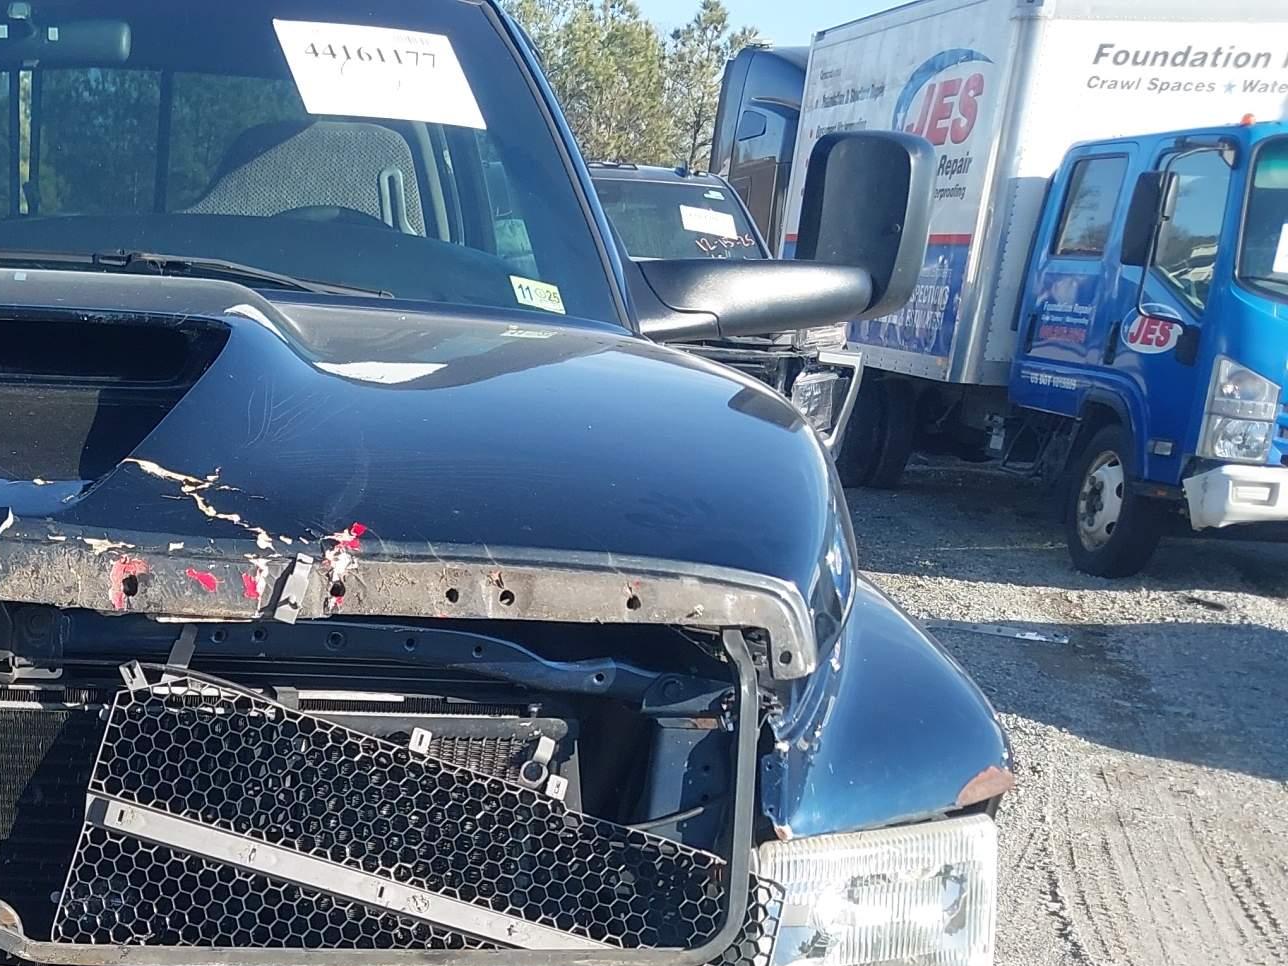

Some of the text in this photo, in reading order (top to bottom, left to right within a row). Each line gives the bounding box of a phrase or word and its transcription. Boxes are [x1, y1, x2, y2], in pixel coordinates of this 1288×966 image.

[305, 43, 436, 68] 44161177
[1092, 43, 1272, 69] Foundation
[1086, 75, 1142, 90] Crawl
[1146, 77, 1216, 94] Spaces
[904, 73, 984, 146] JES
[936, 152, 973, 180] Repair
[518, 284, 560, 303] 11 25
[1128, 316, 1174, 347] JES
